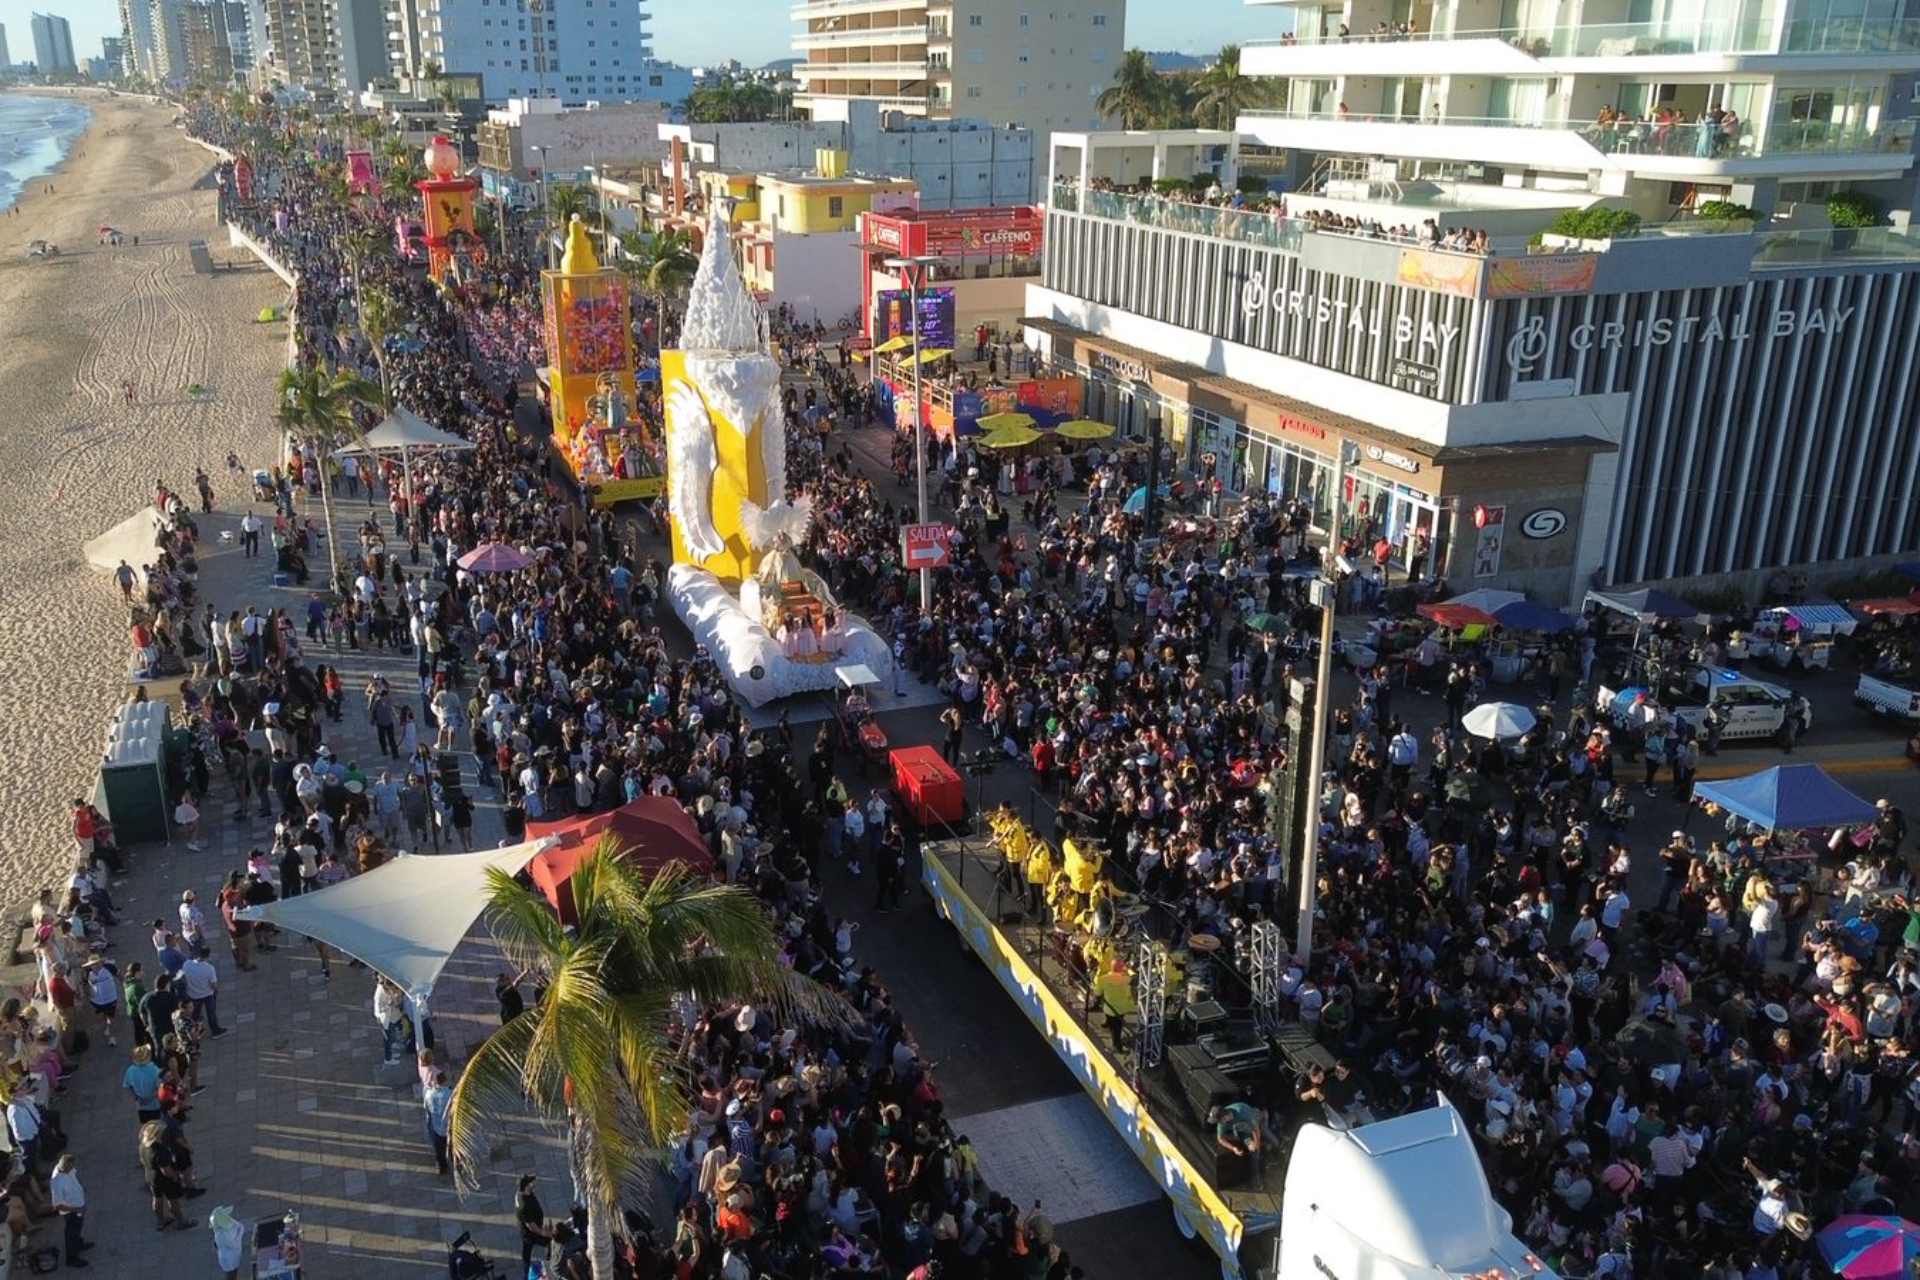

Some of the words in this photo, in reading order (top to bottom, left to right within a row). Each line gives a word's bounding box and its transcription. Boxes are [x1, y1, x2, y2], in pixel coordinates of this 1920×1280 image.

[984, 230, 1031, 243] CAFFENIO
[1273, 287, 1381, 335] CRISTAL
[1395, 315, 1459, 350] BAY
[1570, 315, 1750, 350] CRISTAL
[1773, 307, 1854, 337] BAY
[1419, 369, 1436, 381] CLUB
[910, 526, 946, 542] SALIDA
